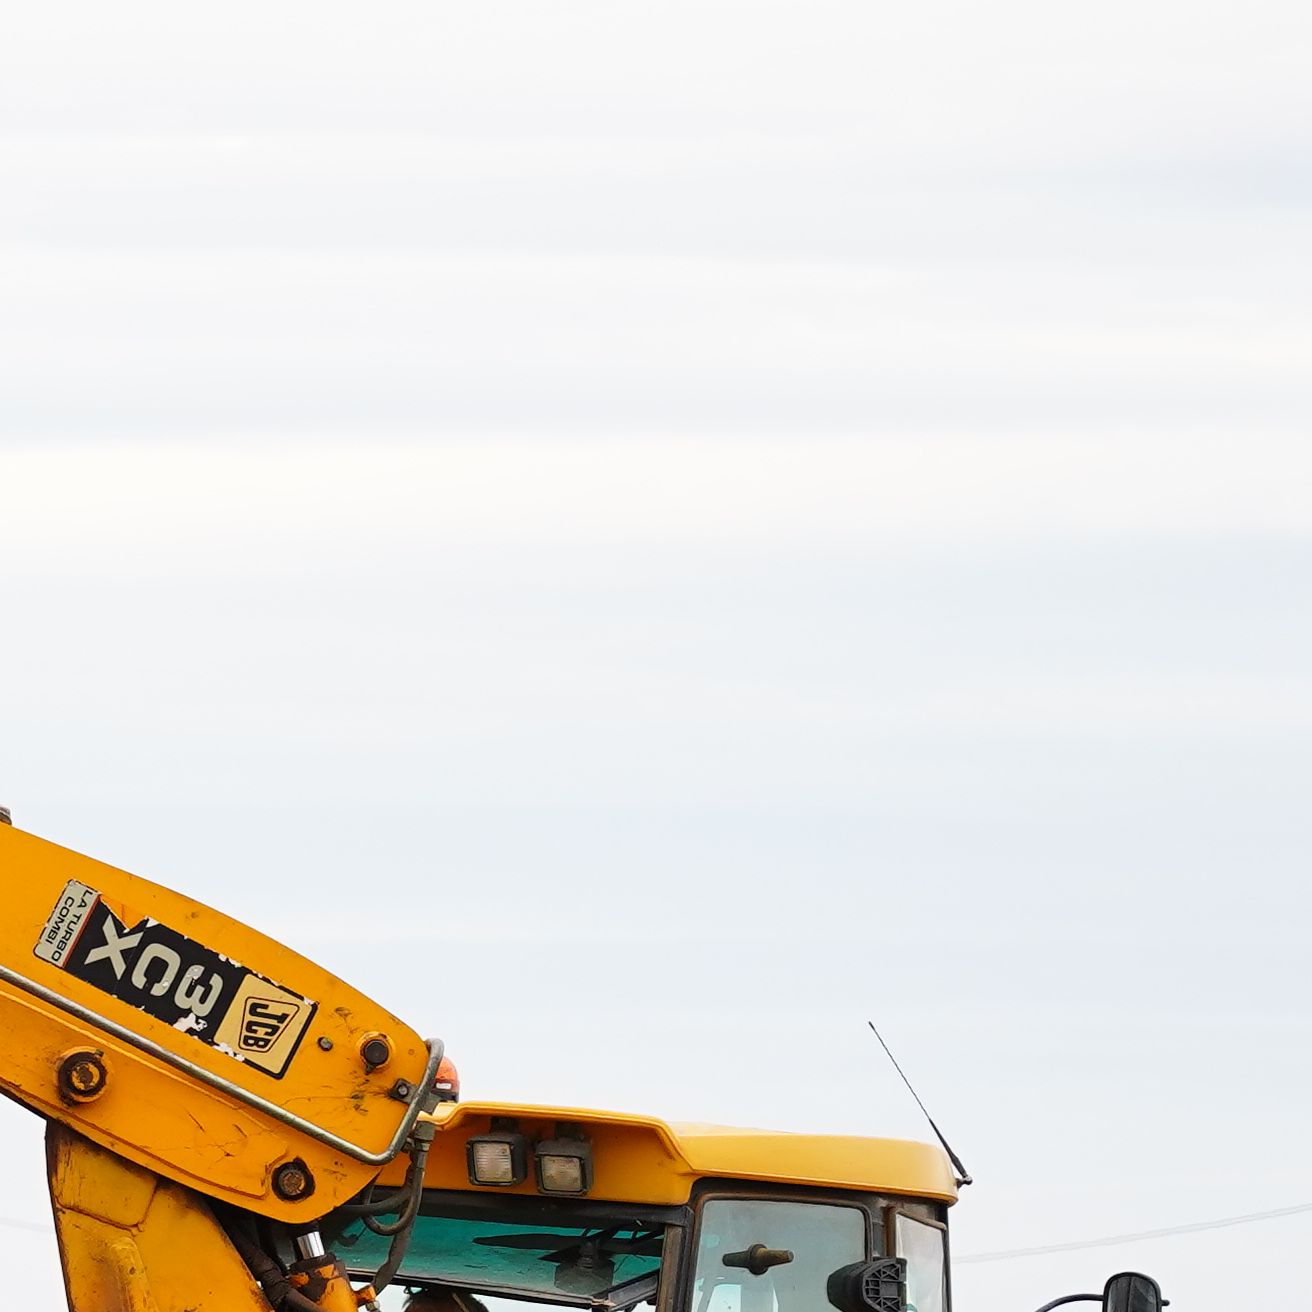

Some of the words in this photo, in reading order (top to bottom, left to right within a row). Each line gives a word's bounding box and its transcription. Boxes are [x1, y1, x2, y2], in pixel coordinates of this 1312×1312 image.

[44, 896, 75, 945] COMBI
[77, 890, 94, 909] LA
[52, 911, 82, 962] TURBO
[243, 1003, 289, 1050] JCB
